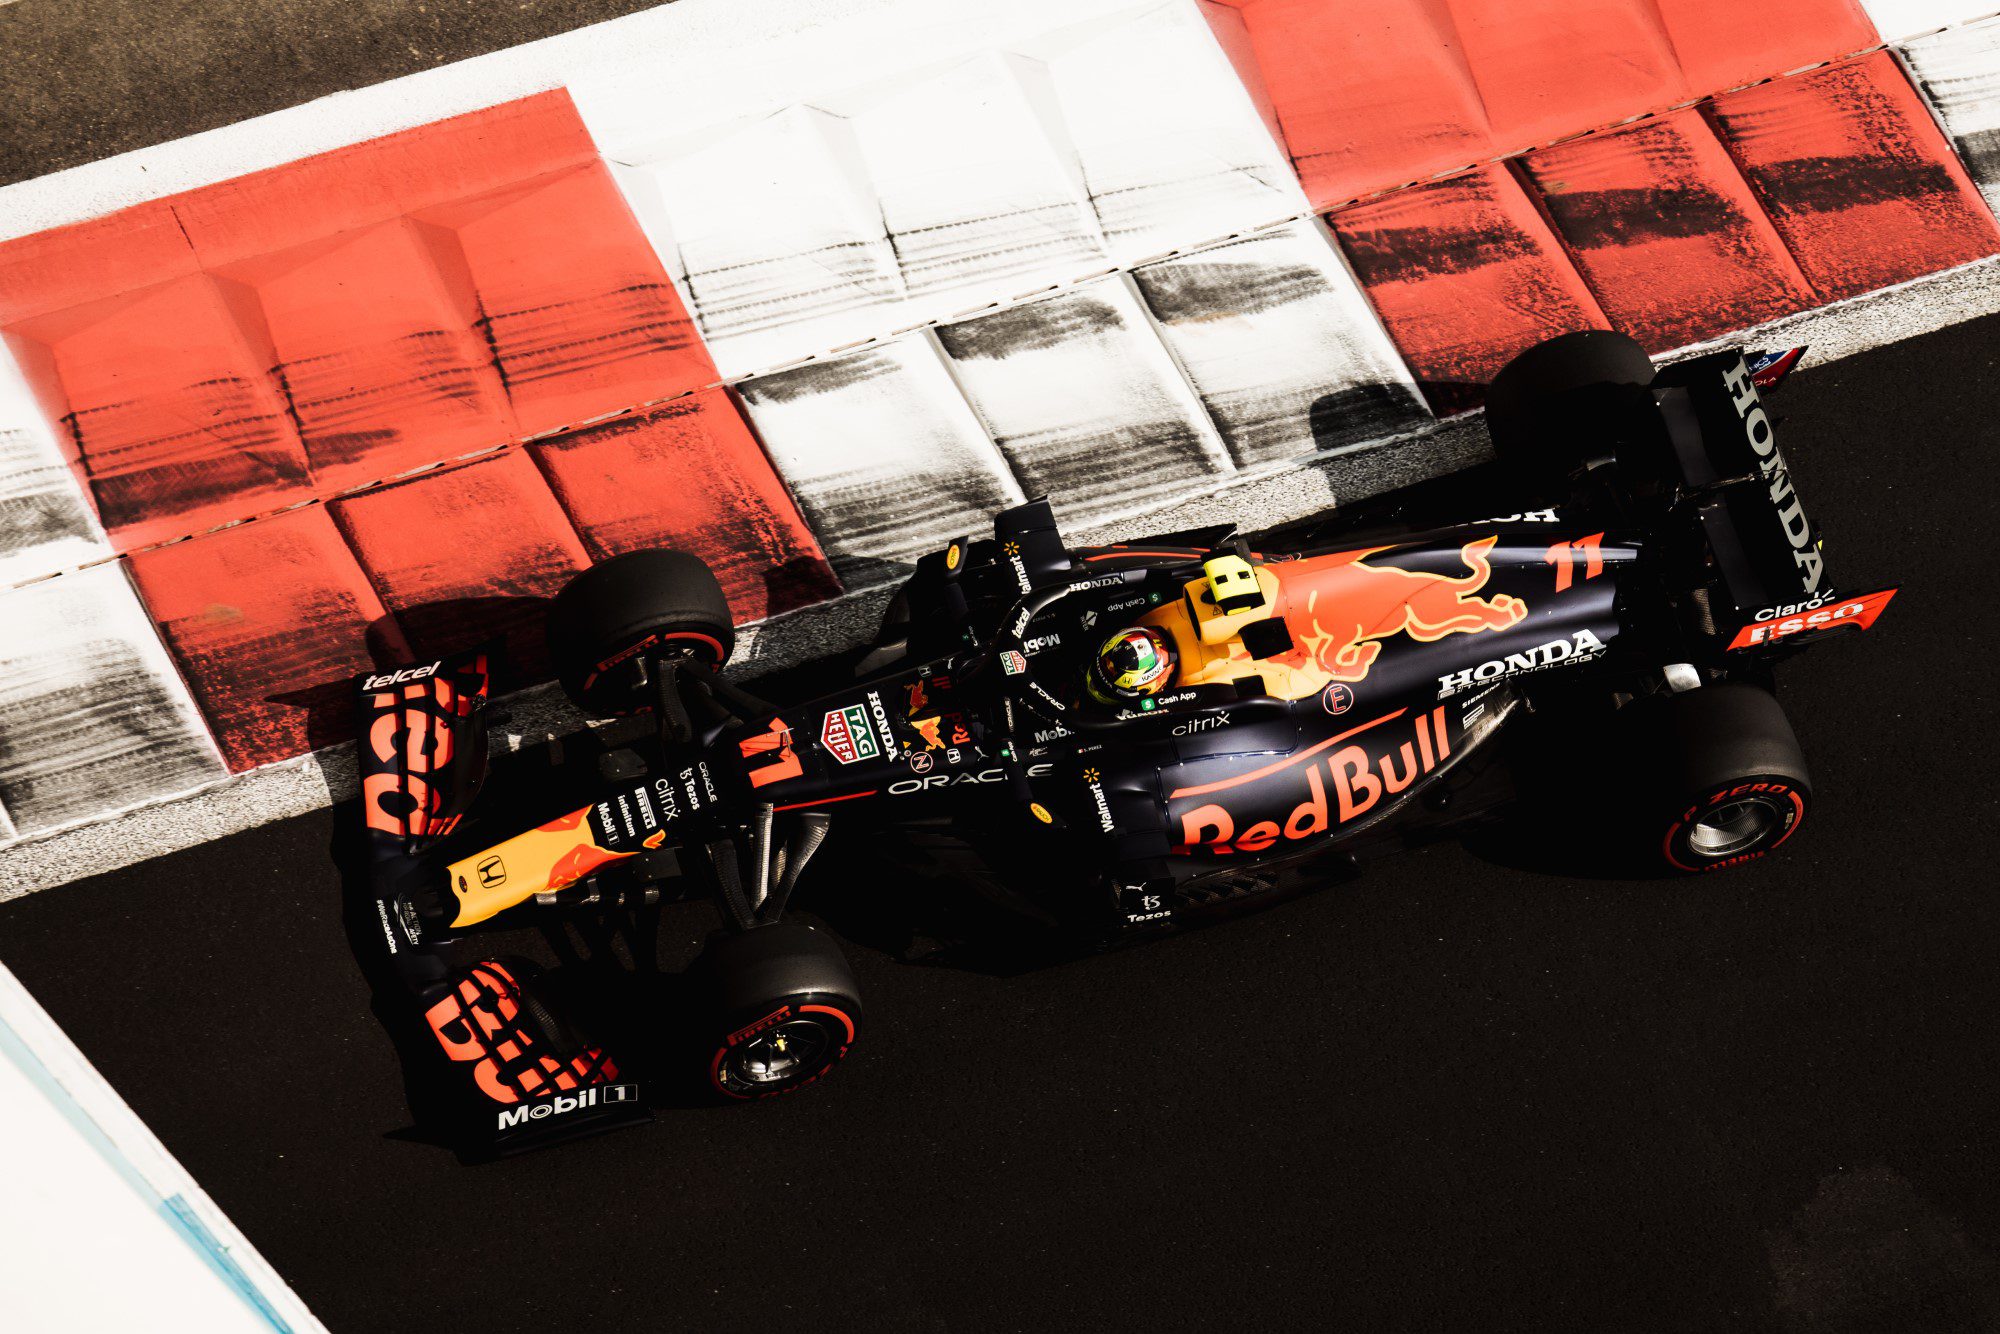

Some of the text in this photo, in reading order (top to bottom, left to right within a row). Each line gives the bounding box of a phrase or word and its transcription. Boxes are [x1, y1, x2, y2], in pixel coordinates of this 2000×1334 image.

[1721, 355, 1824, 594] HONDA
[1009, 557, 1032, 594] almart
[1544, 531, 1604, 594] 11
[1069, 575, 1123, 592] HONDA
[1107, 597, 1145, 612] Cash App
[1755, 596, 1826, 622] Claro
[1011, 607, 1029, 638] telcel
[362, 660, 441, 691] telcel
[1002, 654, 1013, 674] TAG
[1437, 629, 1606, 693] HONDA
[1029, 681, 1065, 711] ORACLE
[1158, 690, 1196, 705] Cash App
[1461, 682, 1501, 709] SIEMENS
[827, 713, 853, 762] HEUER
[847, 710, 873, 755] TAG
[867, 690, 898, 762] HONDA
[1172, 710, 1230, 737] citrix
[738, 717, 803, 788] 11
[684, 778, 701, 811] Tezos
[699, 761, 718, 803] ORACLE
[888, 763, 1053, 795] ORACE
[1707, 783, 1788, 806] ZERO
[617, 794, 636, 837] infinitum
[635, 786, 657, 830] PIRELLI
[655, 778, 679, 822] citrix
[1090, 782, 1115, 833] Walmart
[597, 802, 615, 835] Mobil
[376, 899, 398, 955] #WeRaceAsOne
[1127, 909, 1171, 924] Tezos
[497, 1087, 597, 1131] Mobil
